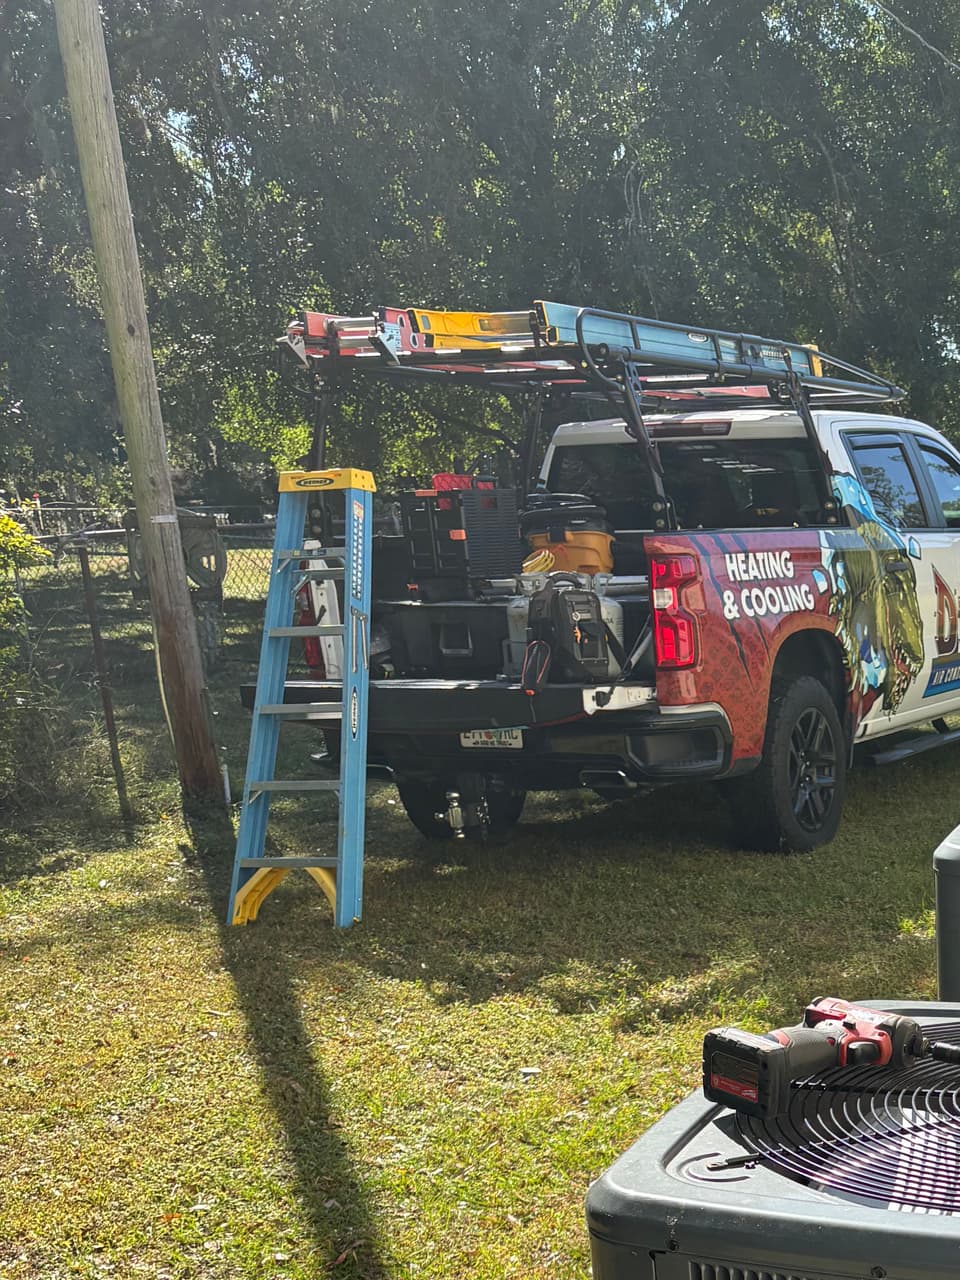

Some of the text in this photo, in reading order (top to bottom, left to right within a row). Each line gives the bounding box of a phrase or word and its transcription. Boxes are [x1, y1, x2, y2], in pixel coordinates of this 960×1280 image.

[725, 551, 794, 581] HEATING
[722, 584, 815, 620] & COOLING
[932, 669, 945, 685] AIR
